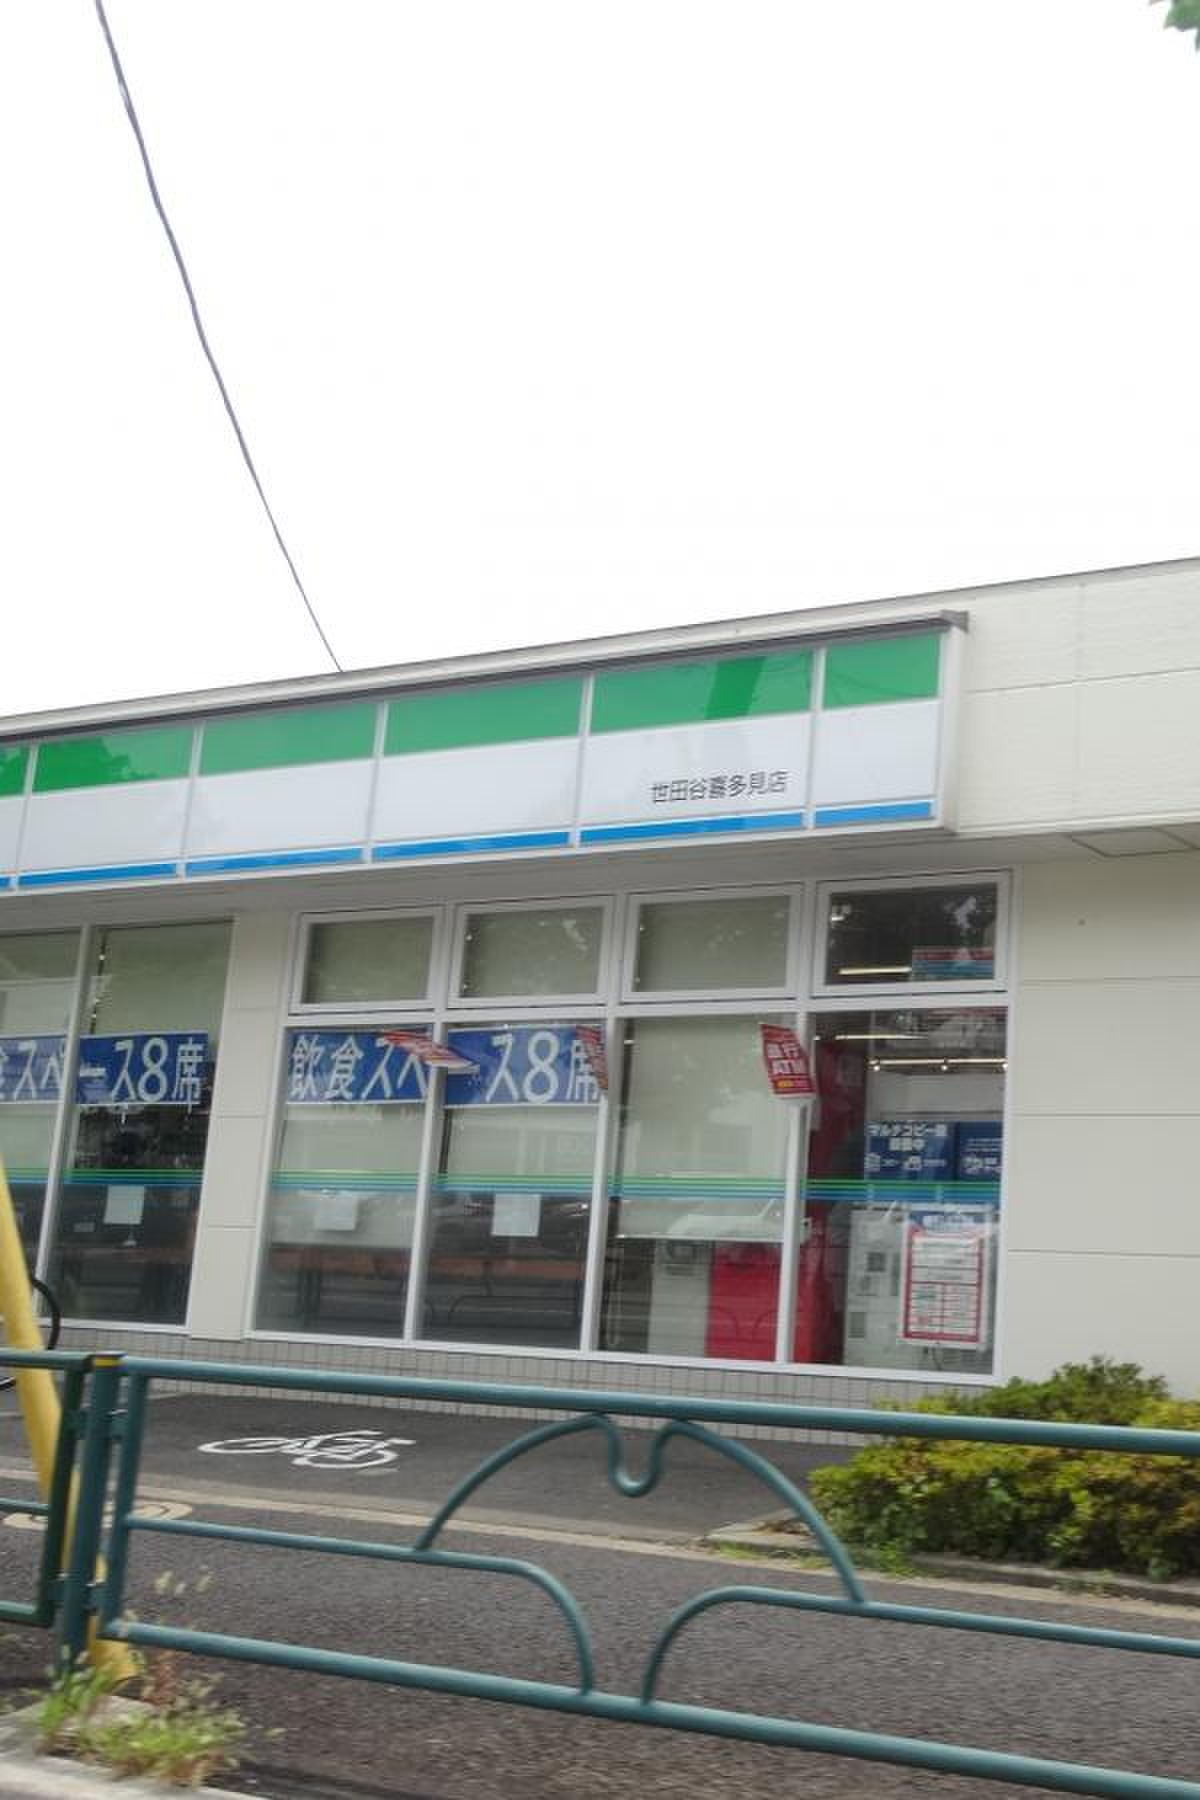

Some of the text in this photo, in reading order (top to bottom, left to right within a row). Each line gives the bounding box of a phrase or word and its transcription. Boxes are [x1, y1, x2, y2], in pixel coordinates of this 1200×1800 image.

[649, 770, 788, 804] 世田谷喜多見店
[0, 1037, 204, 1102] スペース8席
